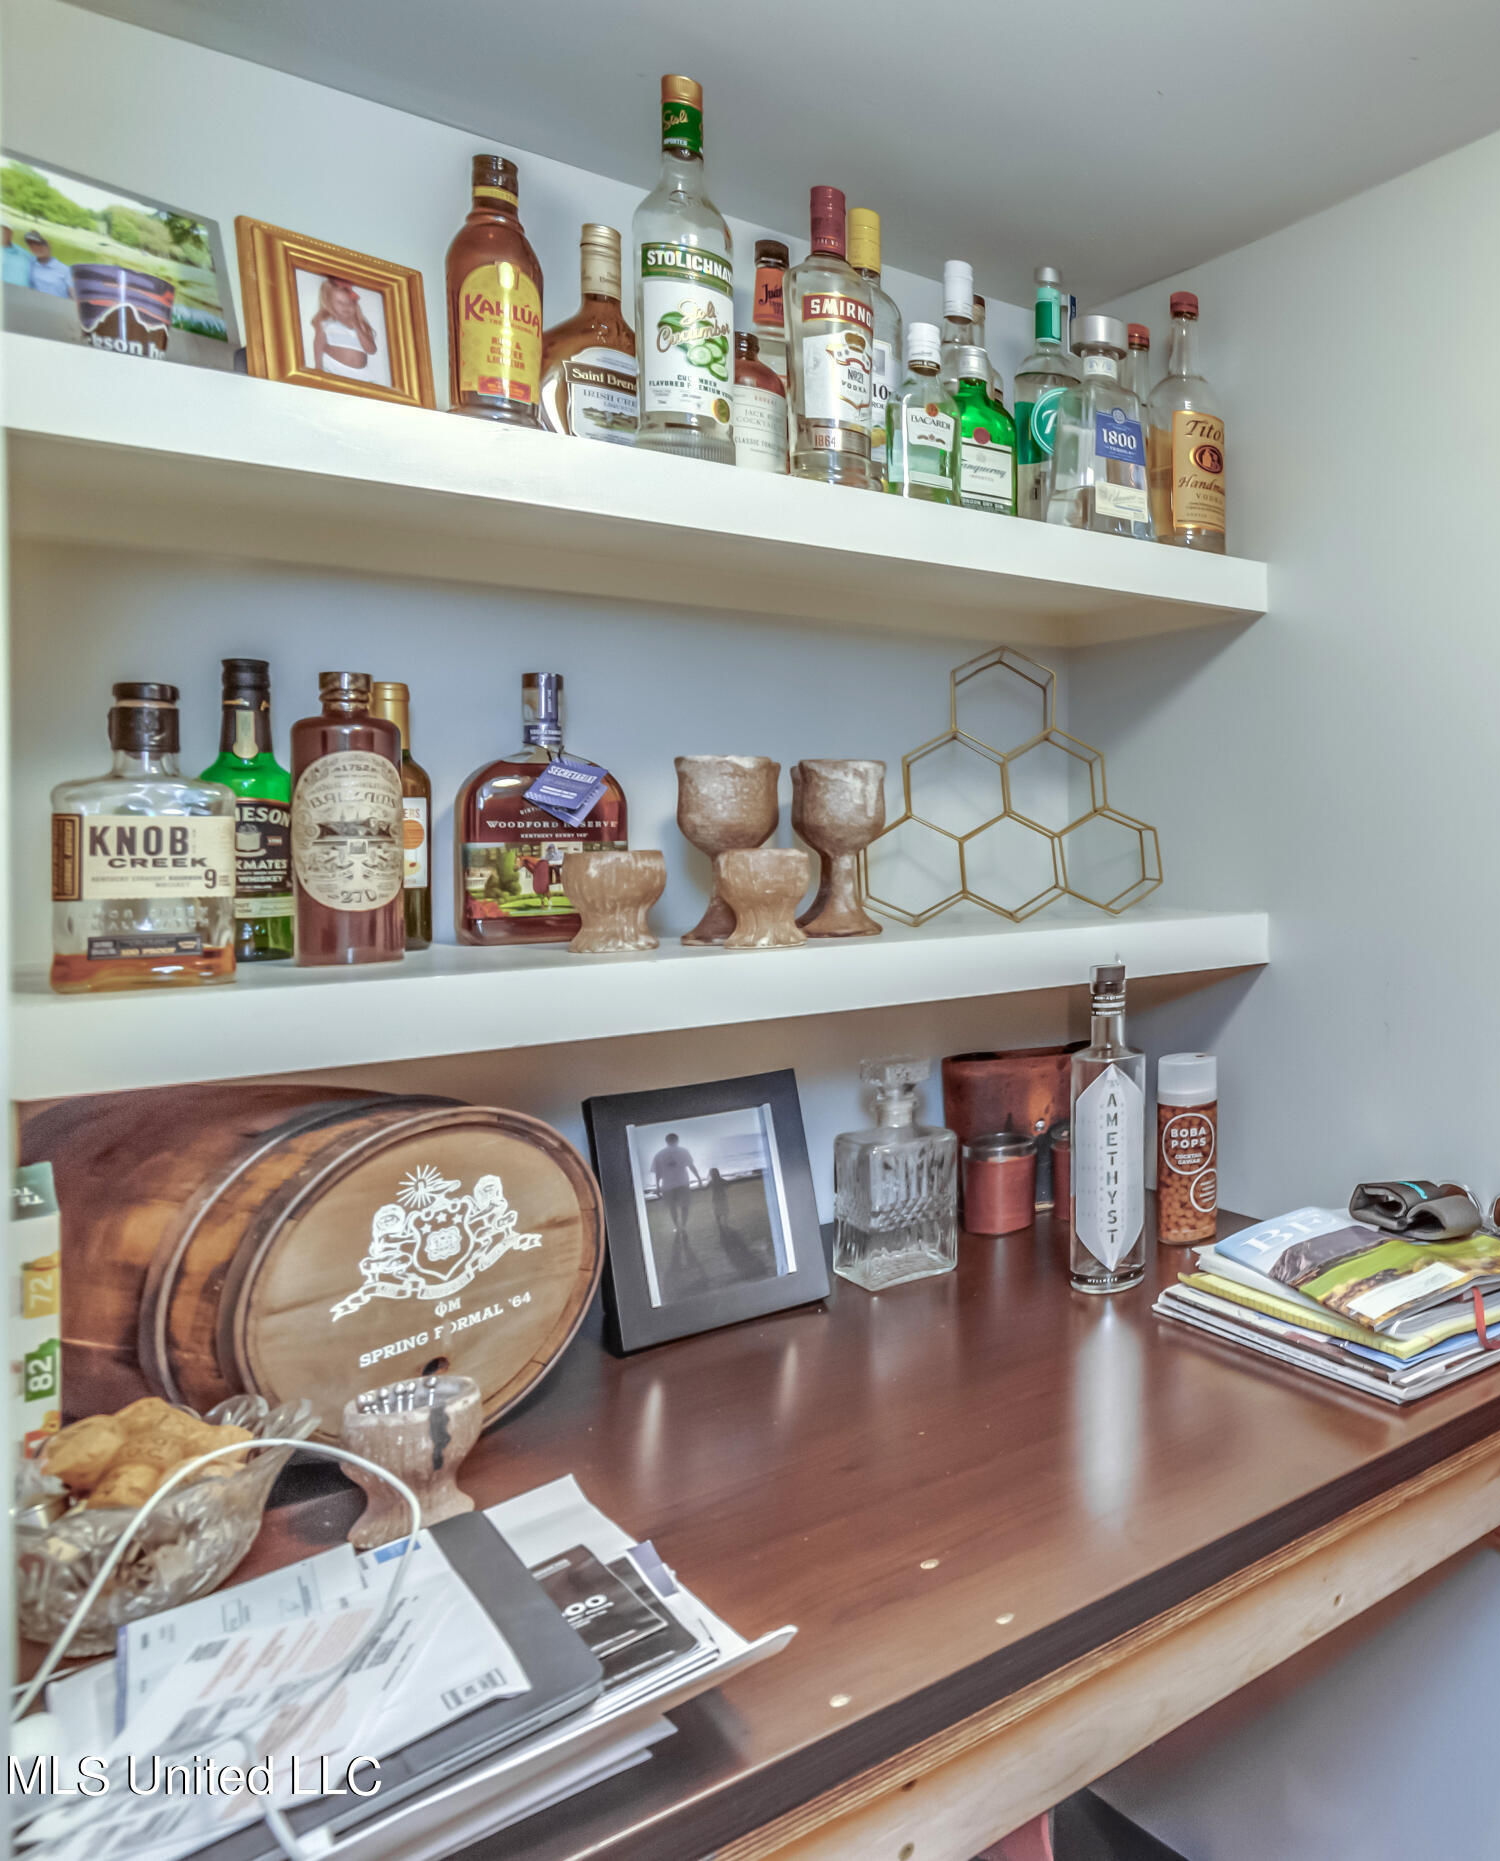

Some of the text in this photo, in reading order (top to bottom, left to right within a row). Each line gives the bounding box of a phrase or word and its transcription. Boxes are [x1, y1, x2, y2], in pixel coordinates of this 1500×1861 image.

[647, 250, 732, 283] STOLICHNAY
[810, 298, 871, 327] SMIRNO
[572, 368, 604, 384] Saint
[649, 380, 685, 388] FLAVORED
[687, 382, 721, 395] PEMIUM
[841, 380, 867, 393] VODKA
[911, 414, 951, 431] BACARDI
[814, 434, 836, 448] 1864
[1102, 427, 1137, 450] 1800
[1178, 474, 1225, 496] Handm
[486, 820, 618, 829] WOODFORD RSERVE
[89, 826, 189, 857] KNOB
[107, 857, 208, 869] CREEK
[204, 869, 217, 889] 9
[1170, 1126, 1207, 1138] BOBA
[1171, 1137, 1207, 1149] POPS
[1106, 1093, 1119, 1244] AMETHYST
[359, 1331, 429, 1368] SPRING
[508, 1291, 532, 1308] '64
[28, 1356, 53, 1393] 82
